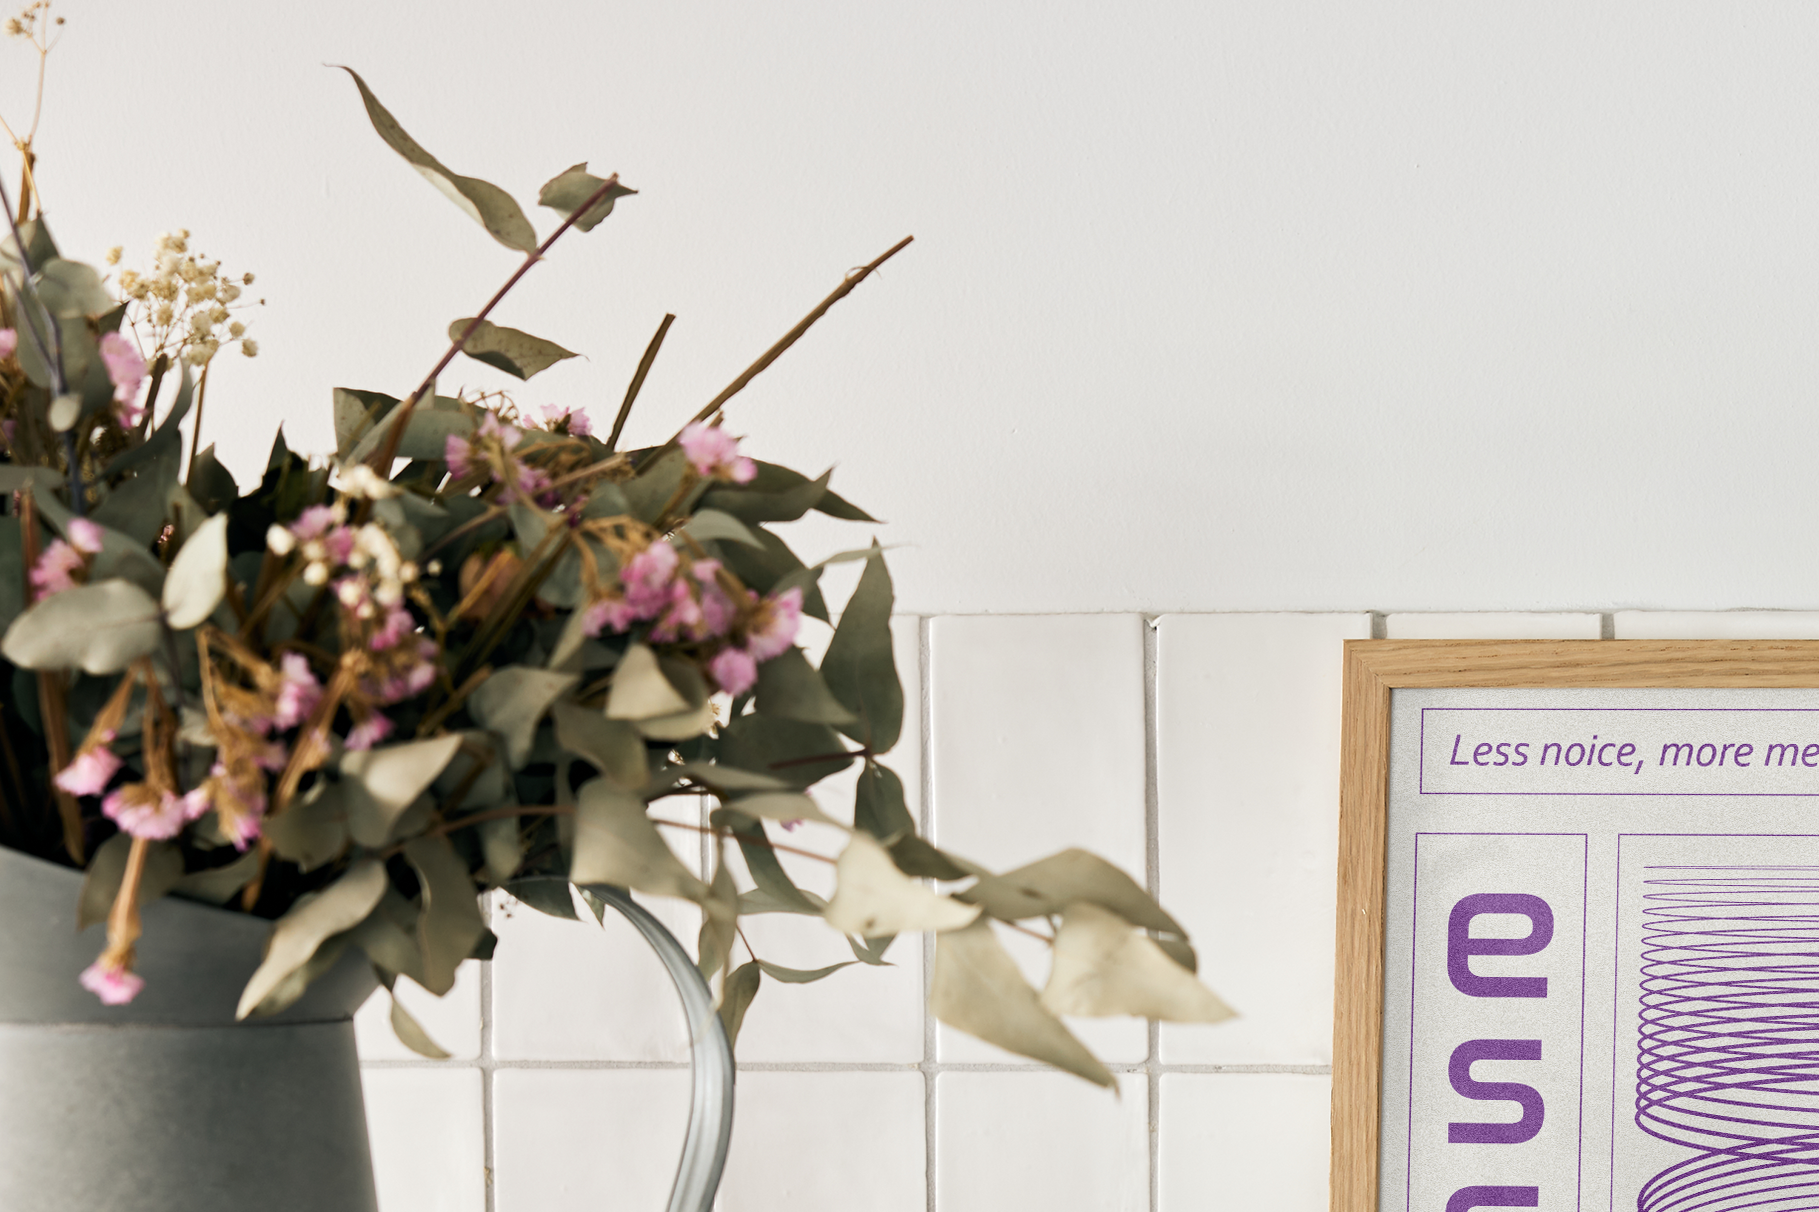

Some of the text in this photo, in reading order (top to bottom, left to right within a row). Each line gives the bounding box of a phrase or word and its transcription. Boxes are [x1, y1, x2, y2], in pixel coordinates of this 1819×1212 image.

[1449, 734, 1531, 768] Less
[1540, 735, 1645, 776] noice,
[1659, 743, 1755, 769] more
